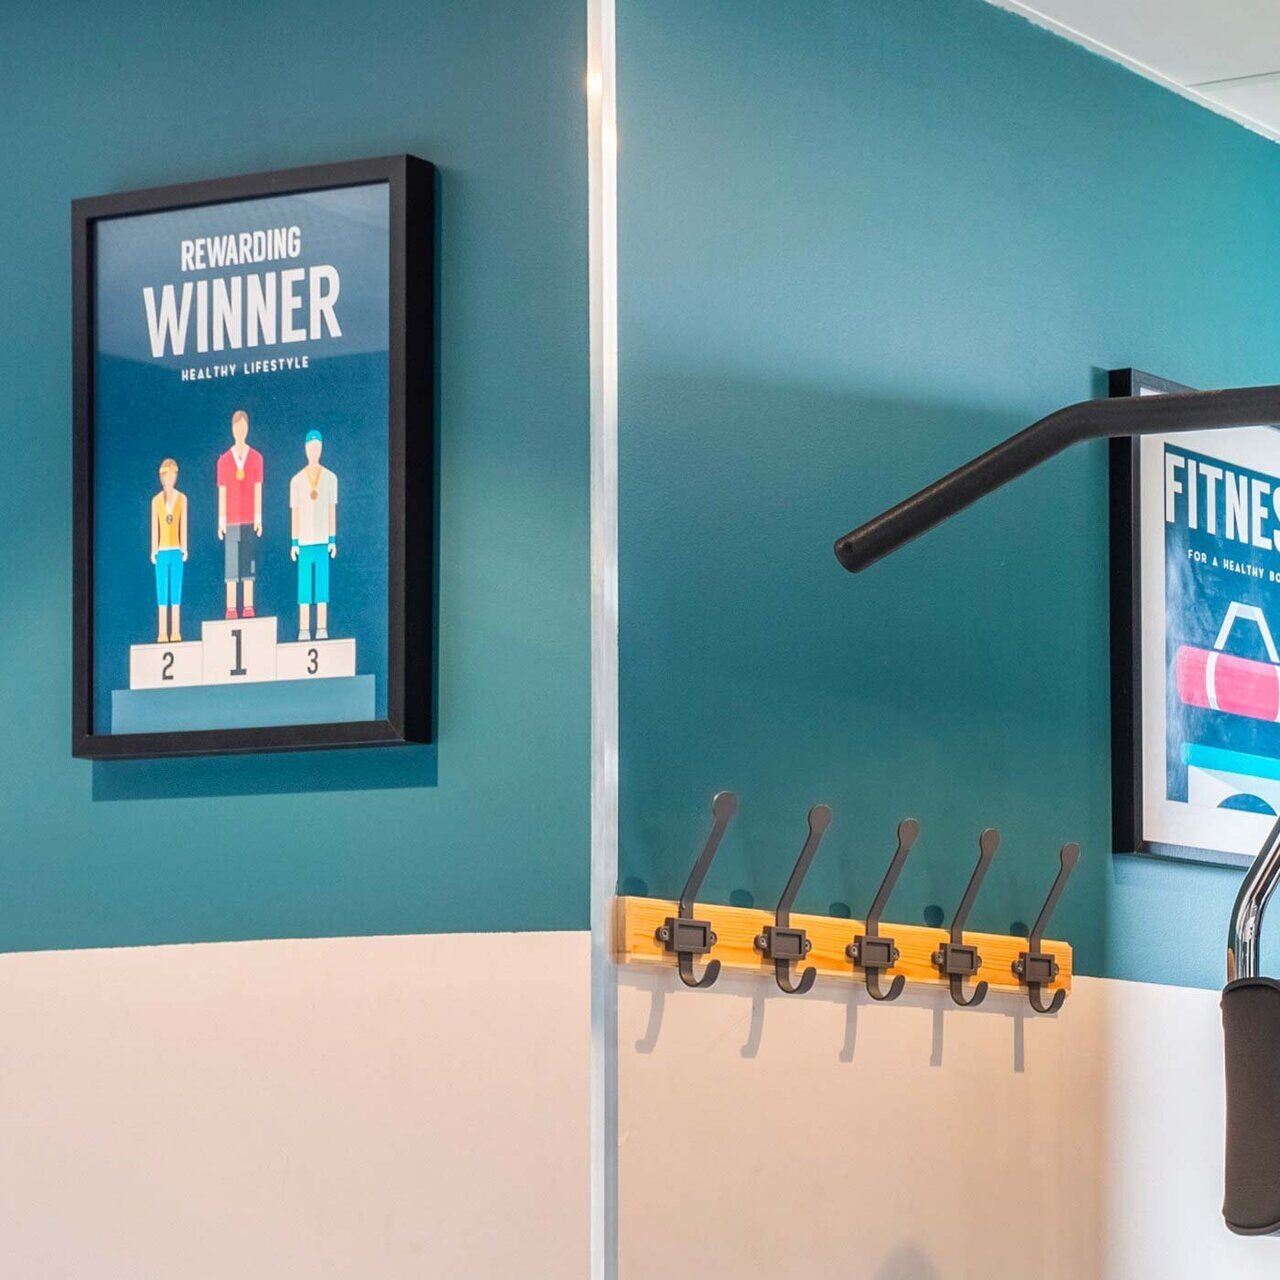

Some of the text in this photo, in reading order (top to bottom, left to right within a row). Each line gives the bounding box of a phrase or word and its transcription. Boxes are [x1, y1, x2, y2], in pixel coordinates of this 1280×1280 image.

[181, 225, 301, 272] REWARDING
[143, 264, 342, 358] WINNER
[181, 356, 309, 381] HEALTHY LIFESTYLE
[1188, 549, 1207, 564] FOR
[1212, 556, 1218, 567] A
[1223, 558, 1264, 579] HEALTHY
[162, 651, 174, 680] 2
[230, 629, 247, 676] 1
[307, 648, 319, 675] 3
